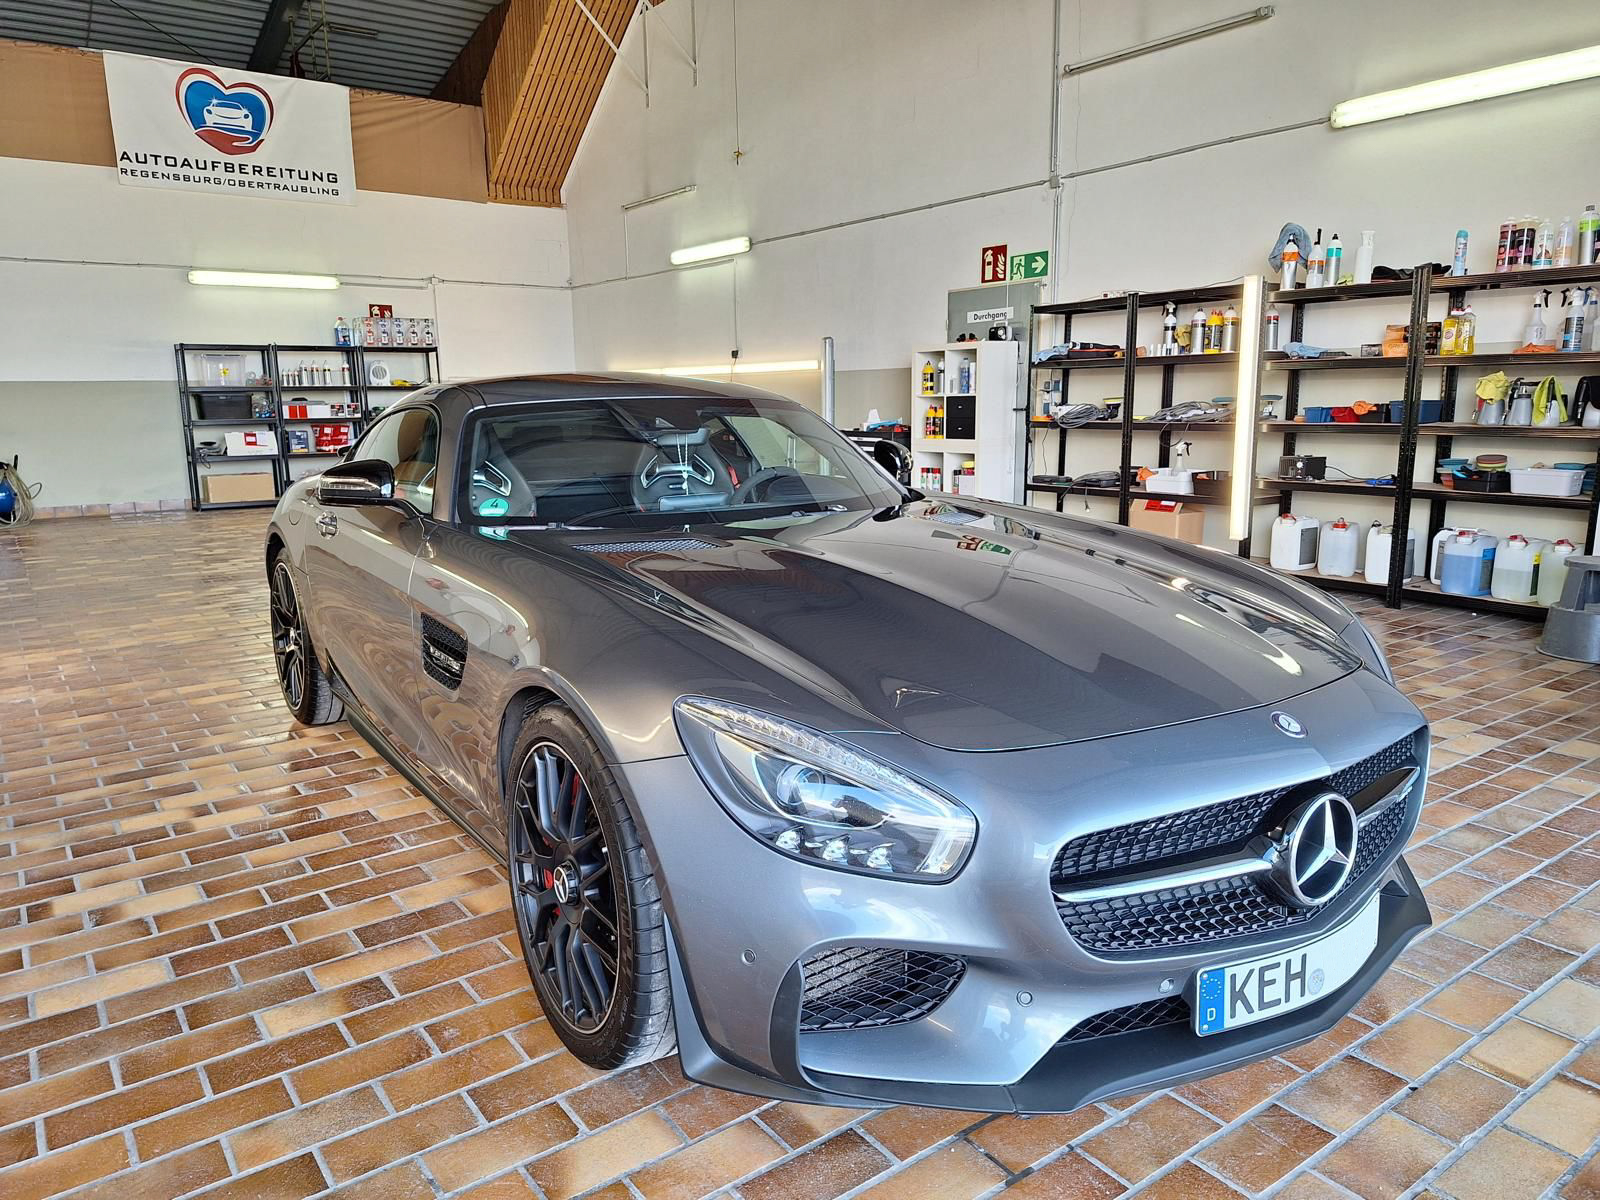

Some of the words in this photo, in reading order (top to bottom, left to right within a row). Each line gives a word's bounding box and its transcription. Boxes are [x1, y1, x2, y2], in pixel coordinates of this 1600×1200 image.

[119, 151, 338, 183] AUTOAUFBEREITUNG
[120, 168, 339, 196] REGENSBURG/OBERTRAUBLING
[973, 312, 1007, 320] Durchgang
[490, 499, 498, 508] 4
[1230, 953, 1307, 1019] KEH
[1206, 1007, 1217, 1021] D
